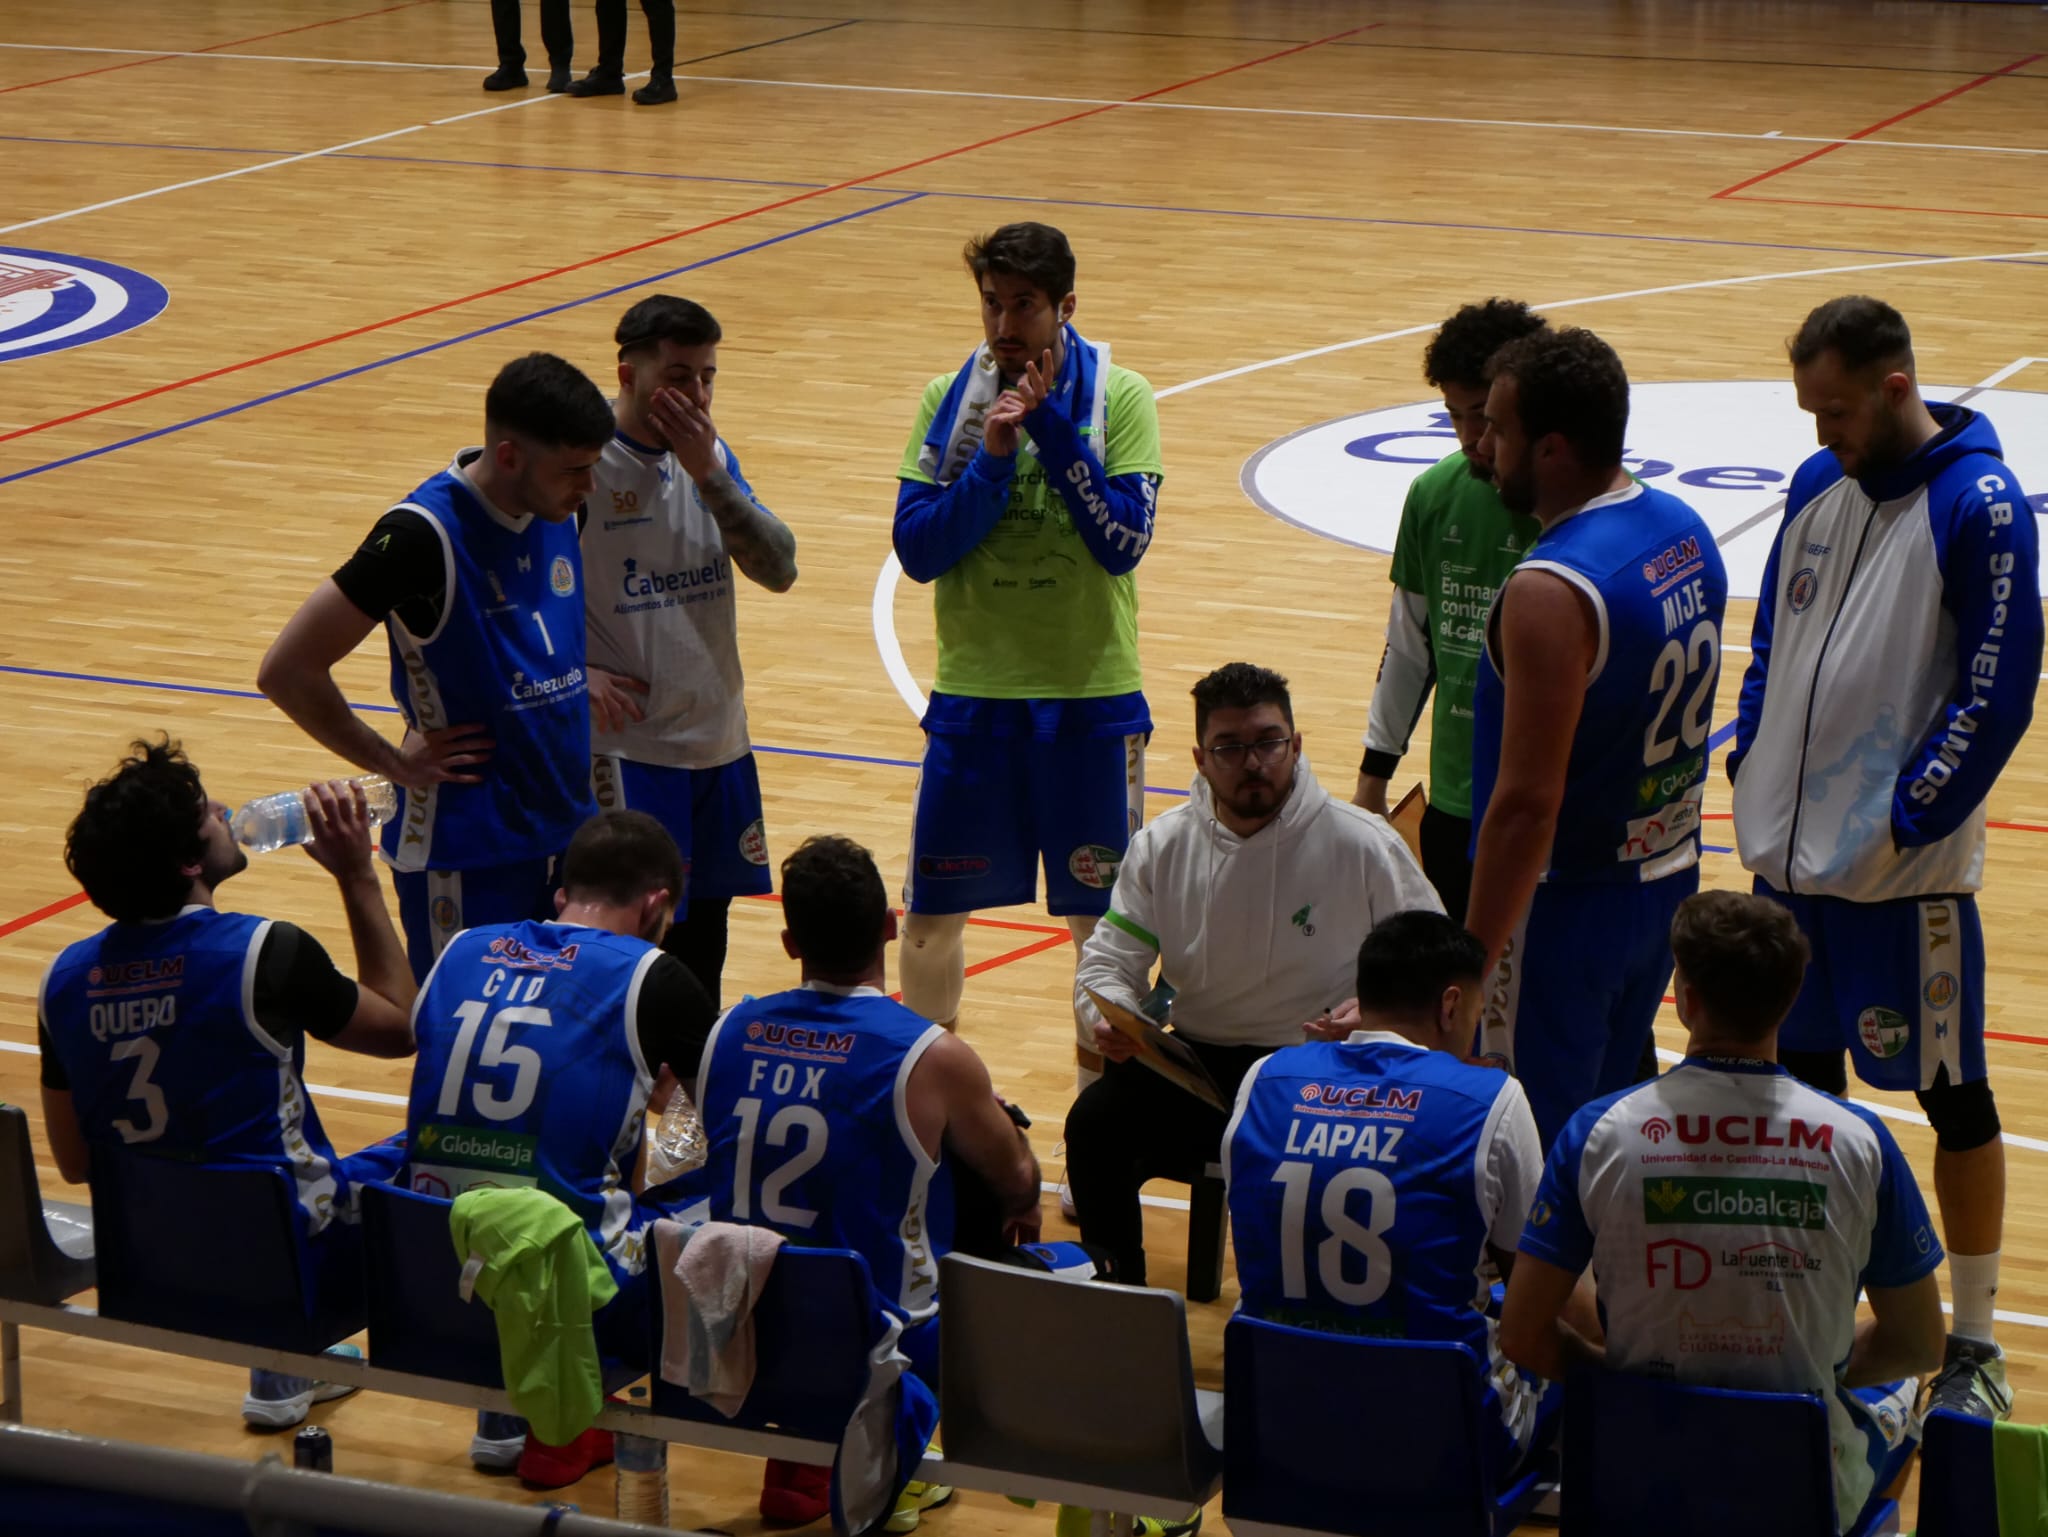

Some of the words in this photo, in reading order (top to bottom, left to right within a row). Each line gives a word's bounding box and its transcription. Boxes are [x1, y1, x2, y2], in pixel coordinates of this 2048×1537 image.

[612, 490, 638, 510] 50
[1976, 473, 2014, 538] C.B.
[1651, 535, 1702, 580] UCLM
[1441, 577, 1460, 597] En
[1662, 578, 1707, 636] MIJE
[531, 610, 555, 656] 1
[511, 667, 583, 700] Cabezuelo
[1642, 619, 1719, 768] 22
[105, 955, 185, 985] UCLM
[482, 968, 546, 1002] CID
[89, 994, 176, 1042] QUERO
[764, 1023, 856, 1054] UCLM
[436, 1000, 552, 1121] 15
[748, 1058, 827, 1100] FOX
[109, 1035, 169, 1145] 3
[1320, 1085, 1423, 1111] UCLM
[440, 1135, 533, 1167] Globalcaja
[1284, 1118, 1404, 1164] LAPAZ
[1676, 1114, 1834, 1153] UCLM
[731, 1097, 830, 1230] 12
[1641, 1154, 1706, 1164] Universidad
[1711, 1154, 1723, 1163] de
[1727, 1153, 1786, 1166] Castilla-La
[1789, 1158, 1830, 1172] Mancha
[1692, 1188, 1825, 1227] Globalcaja
[1270, 1160, 1397, 1306] 18
[1647, 1238, 1711, 1290] FD
[1679, 1343, 1742, 1353] CIUDAD
[1746, 1343, 1784, 1356] REAL
